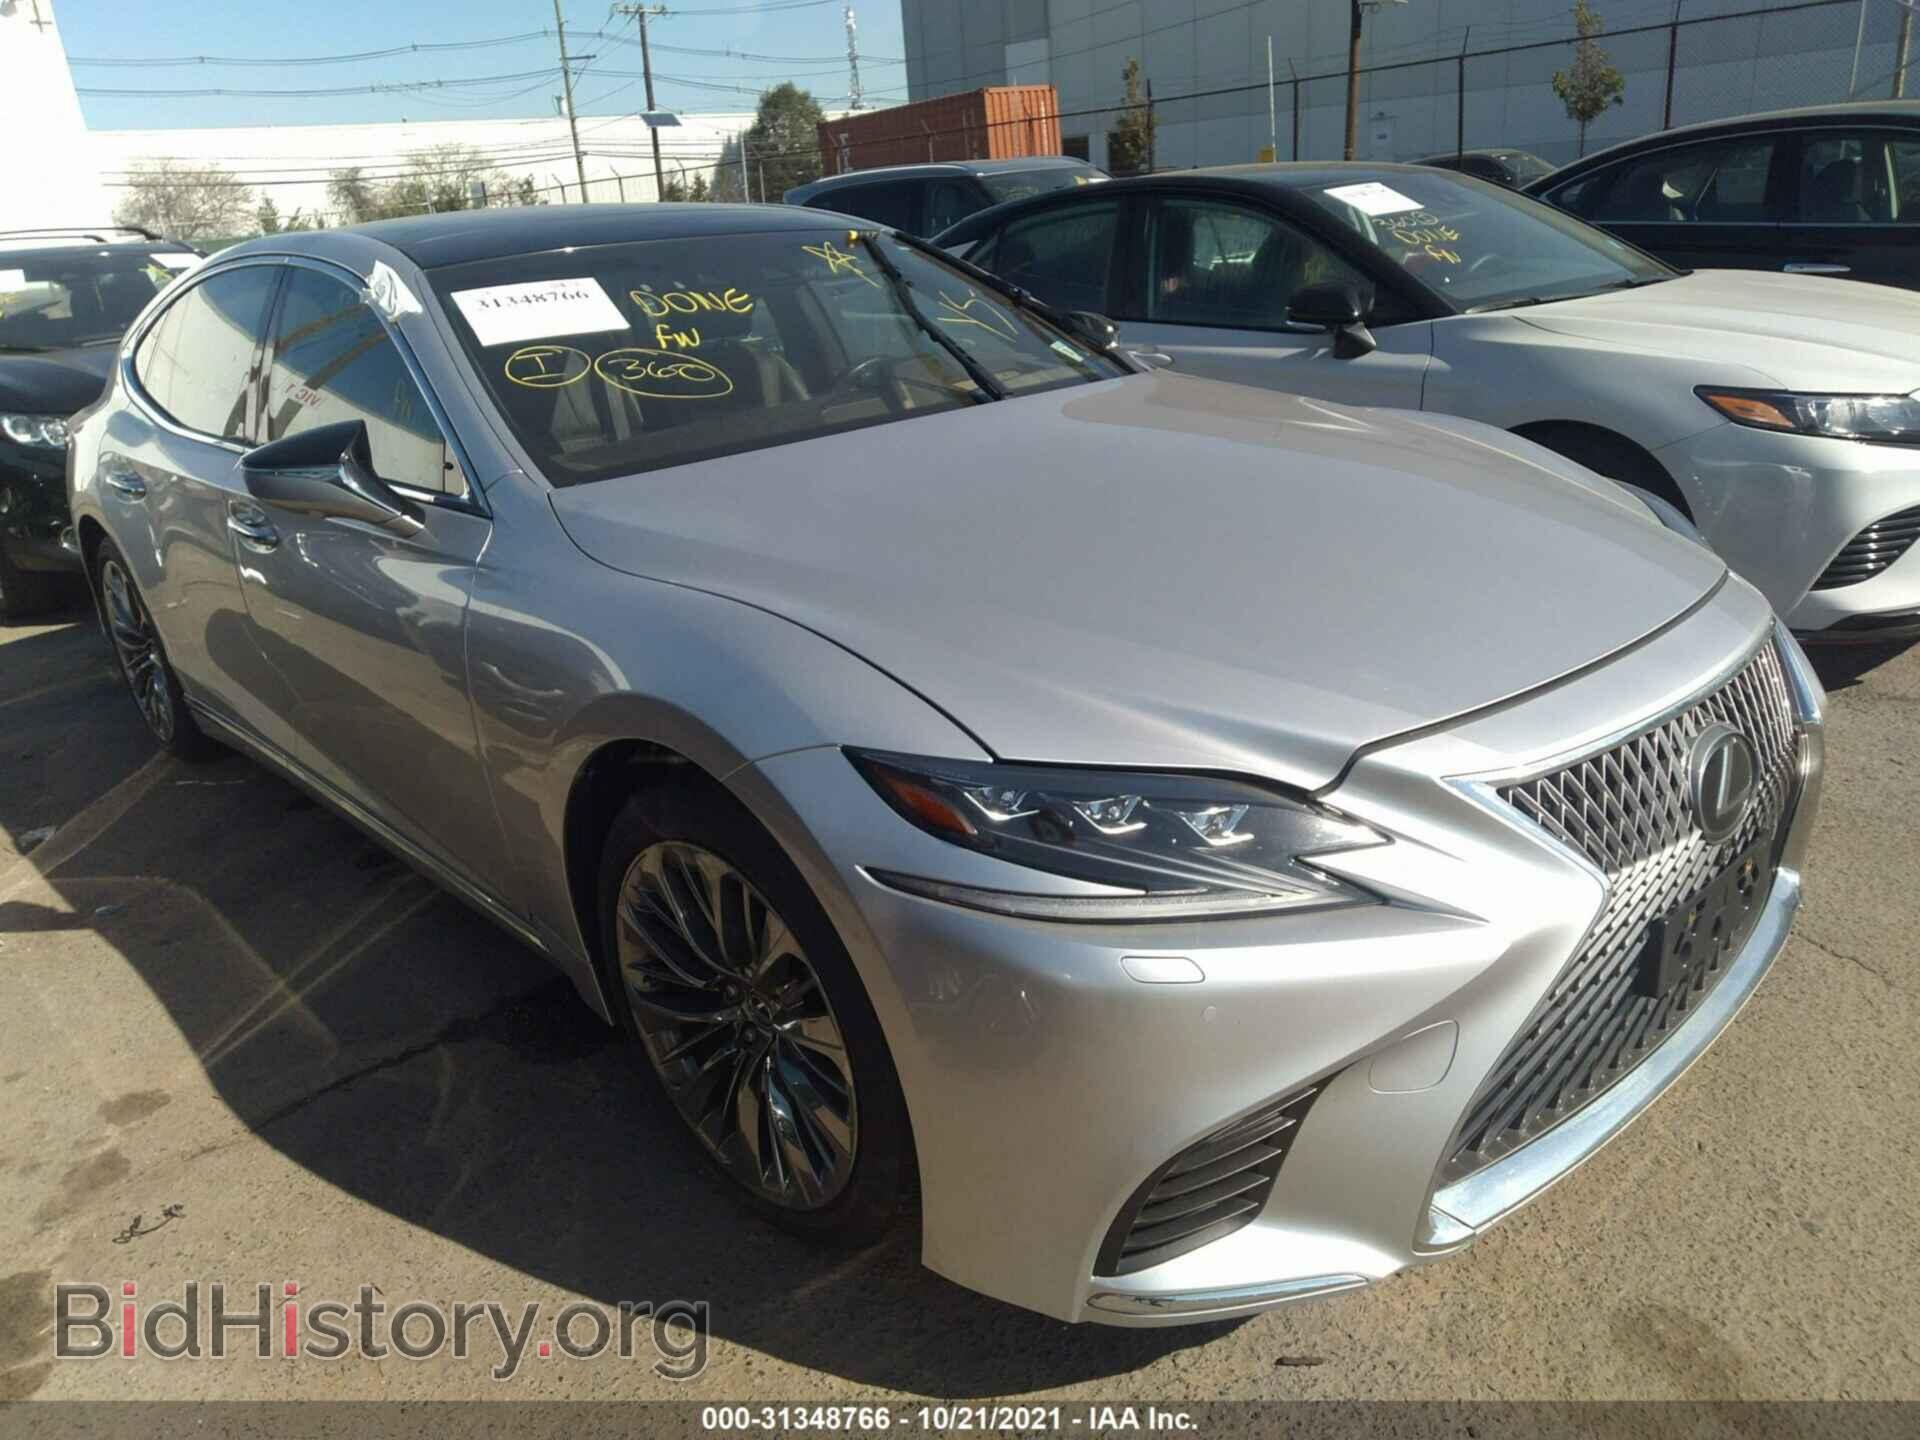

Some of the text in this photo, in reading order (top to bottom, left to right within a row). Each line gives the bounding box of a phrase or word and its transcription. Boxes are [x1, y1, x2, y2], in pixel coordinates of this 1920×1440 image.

[630, 287, 753, 317] DONE
[655, 323, 701, 349] FW
[607, 357, 716, 382] 360
